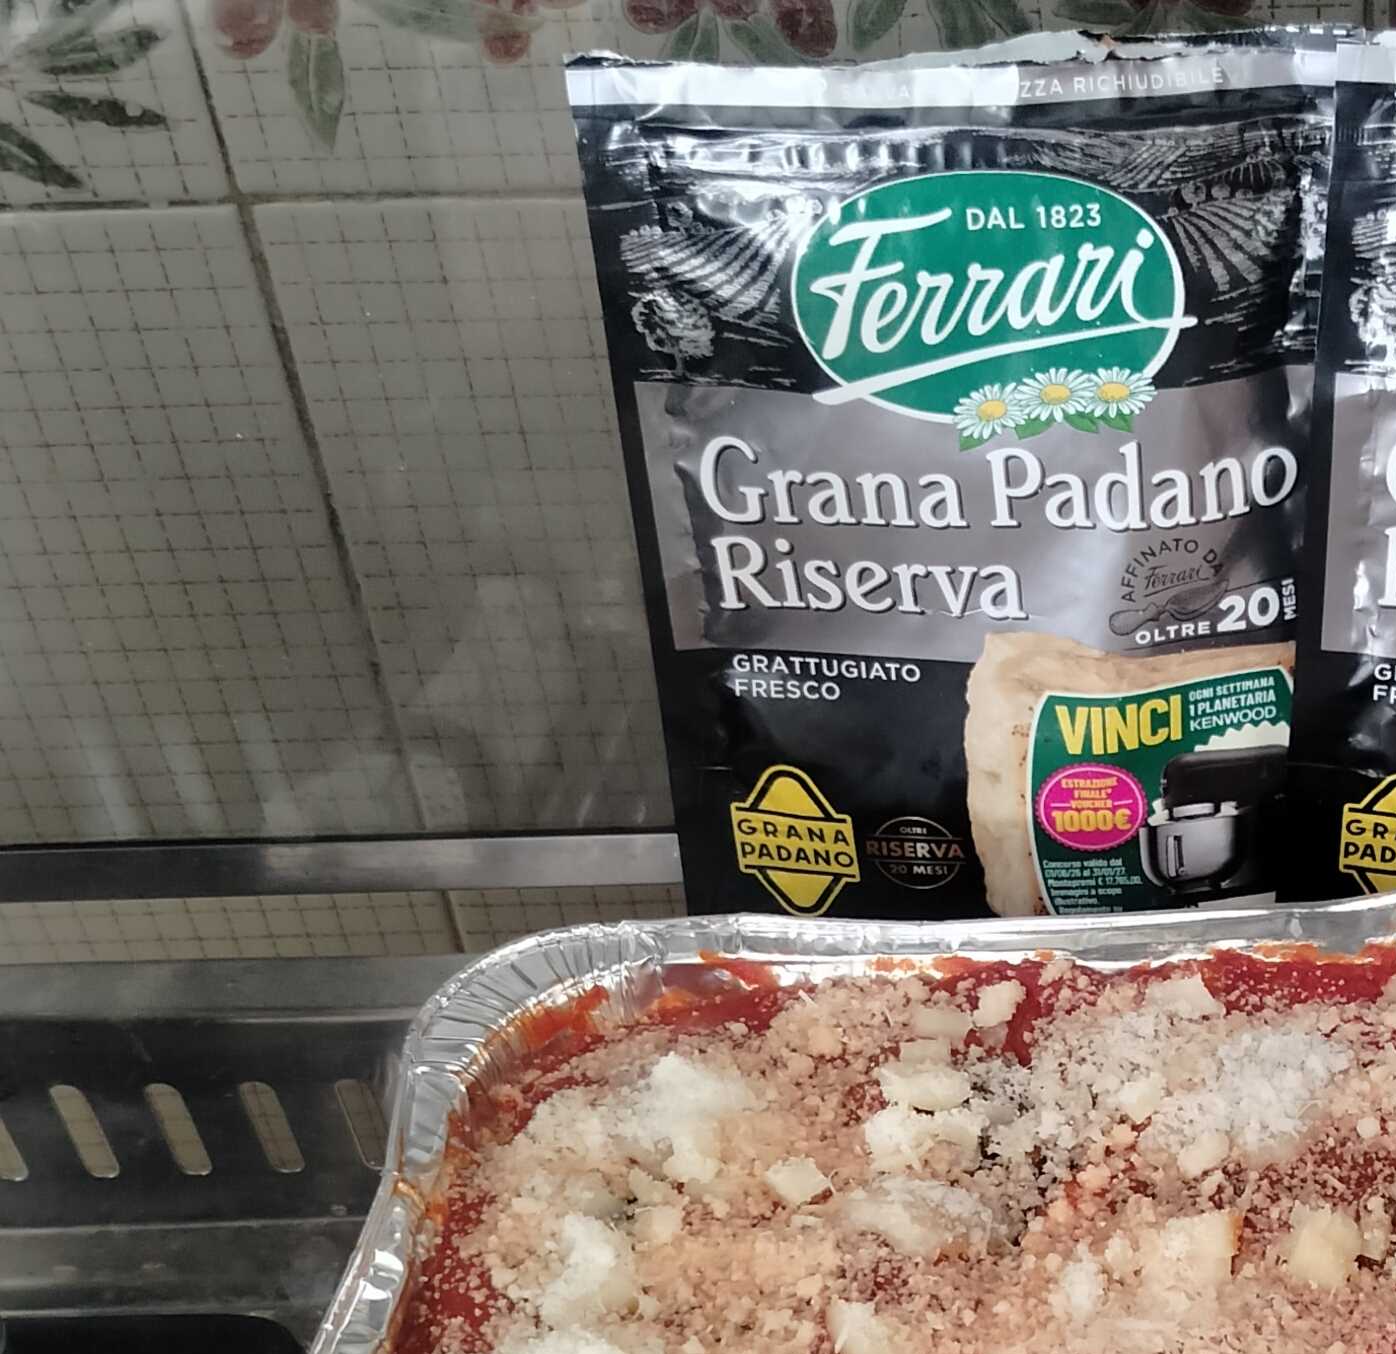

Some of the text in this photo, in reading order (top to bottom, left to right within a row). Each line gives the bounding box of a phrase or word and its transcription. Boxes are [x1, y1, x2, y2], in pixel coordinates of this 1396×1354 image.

[1073, 67, 1225, 94] RICHIUDIBILE
[965, 201, 1102, 231] DAL 1823
[811, 208, 1165, 361] Ferrari
[700, 436, 1298, 531] Grana Padano
[710, 536, 1027, 620] Riserva
[1121, 538, 1224, 602] AFFINATO DA
[1135, 577, 1297, 645] OLTRE 20 MESI
[733, 654, 921, 683] GRATTUGIATO
[734, 678, 841, 700] FRESCO
[1188, 676, 1275, 701] OGNI SETTIMANA
[1198, 689, 1276, 714] PLANETARIA
[1055, 694, 1182, 755] VINCI
[1189, 705, 1277, 731] KENWOOD
[737, 819, 850, 846] GRANA
[1051, 808, 1132, 832] 1000€
[740, 841, 854, 867] PADANO
[865, 841, 965, 859] RISERVA
[912, 865, 948, 875] MESI
